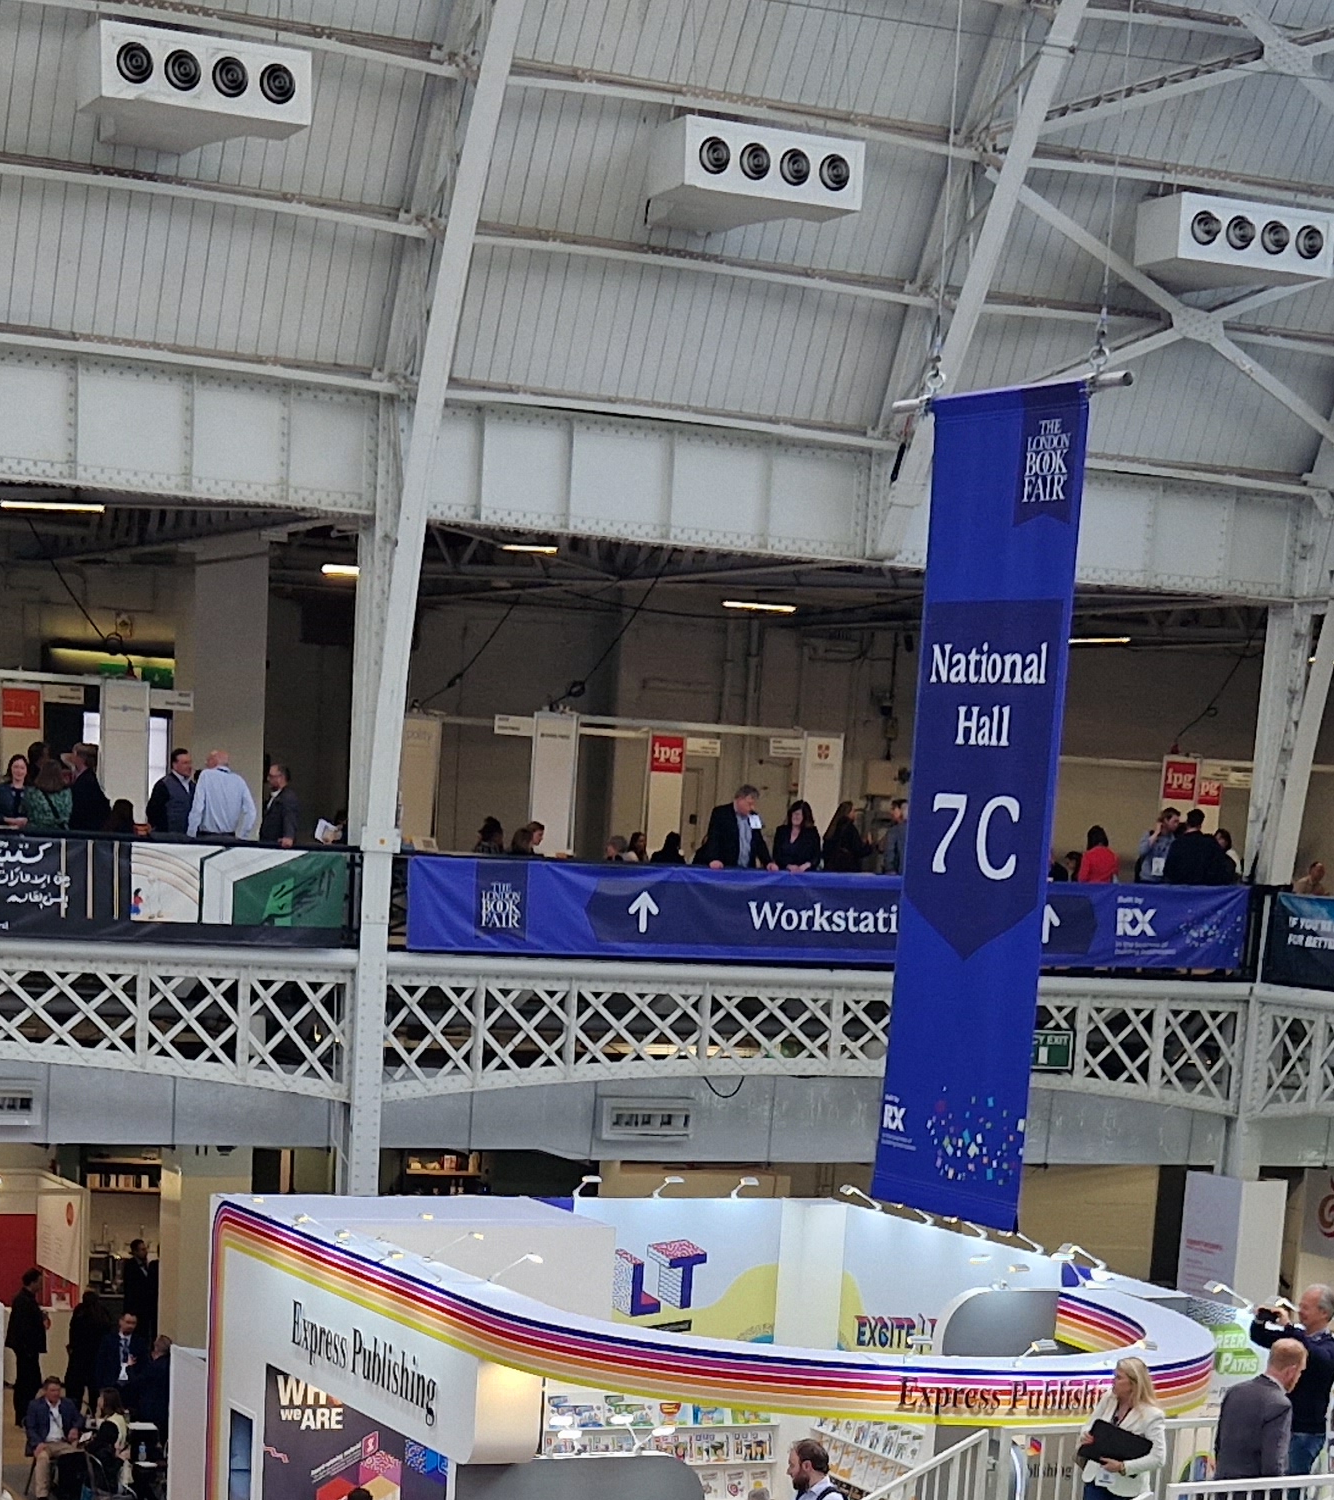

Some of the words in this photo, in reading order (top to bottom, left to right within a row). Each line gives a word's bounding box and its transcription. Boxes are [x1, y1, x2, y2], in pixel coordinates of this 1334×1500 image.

[1038, 419, 1062, 435] THE
[1027, 432, 1071, 452] LONDON
[1024, 448, 1068, 477] BOOK
[1021, 473, 1068, 502] FAIR
[929, 642, 1047, 686] National
[955, 706, 1010, 748] Hall
[653, 741, 683, 764] ipg
[1167, 767, 1195, 790] ipg
[931, 792, 1022, 881] 7C
[482, 890, 521, 901] LONDON
[491, 881, 513, 893] THE
[481, 899, 521, 914] BOOK
[748, 899, 898, 934] Workstati
[481, 912, 521, 928] FAIR
[1116, 907, 1157, 937] RX
[1288, 916, 1297, 929] IF
[1287, 932, 1303, 947] FOR
[1046, 1035, 1069, 1046] EXIT
[883, 1104, 907, 1132] RX
[291, 1299, 348, 1370] Express
[351, 1326, 437, 1427] Publishing
[898, 1376, 1002, 1412] Express
[300, 1407, 344, 1431] ARE
